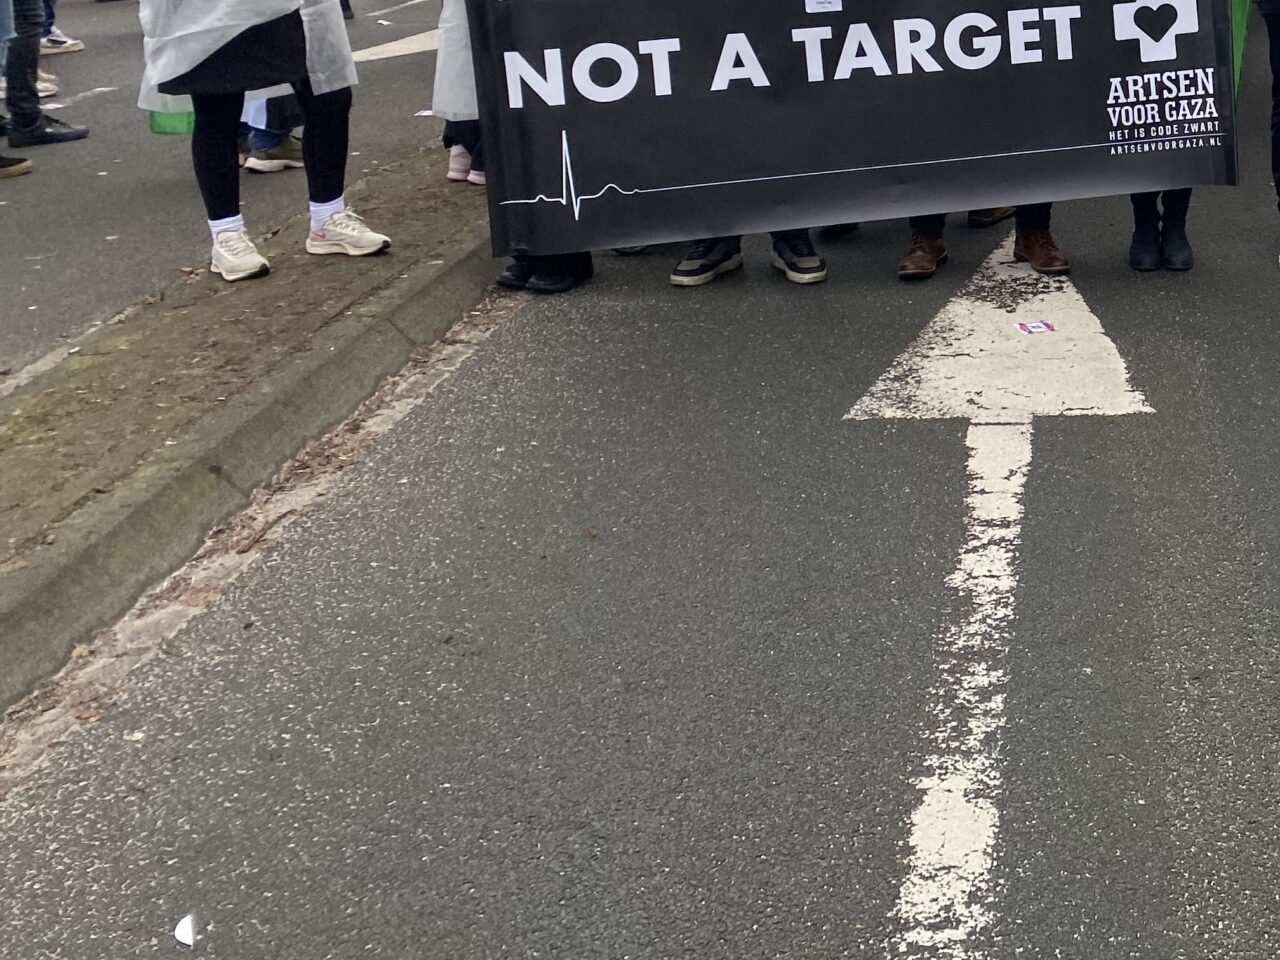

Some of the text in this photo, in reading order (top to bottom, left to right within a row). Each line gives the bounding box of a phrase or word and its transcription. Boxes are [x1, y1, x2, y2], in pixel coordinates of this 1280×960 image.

[503, 5, 1082, 109] NOT A TARGET
[1106, 68, 1214, 104] ARTSEN
[1106, 97, 1219, 127] VOOR GAZA
[1109, 121, 1220, 141] HET IS CODE ZWART
[1110, 137, 1222, 156] ARTSENVOORGAZA.NL
